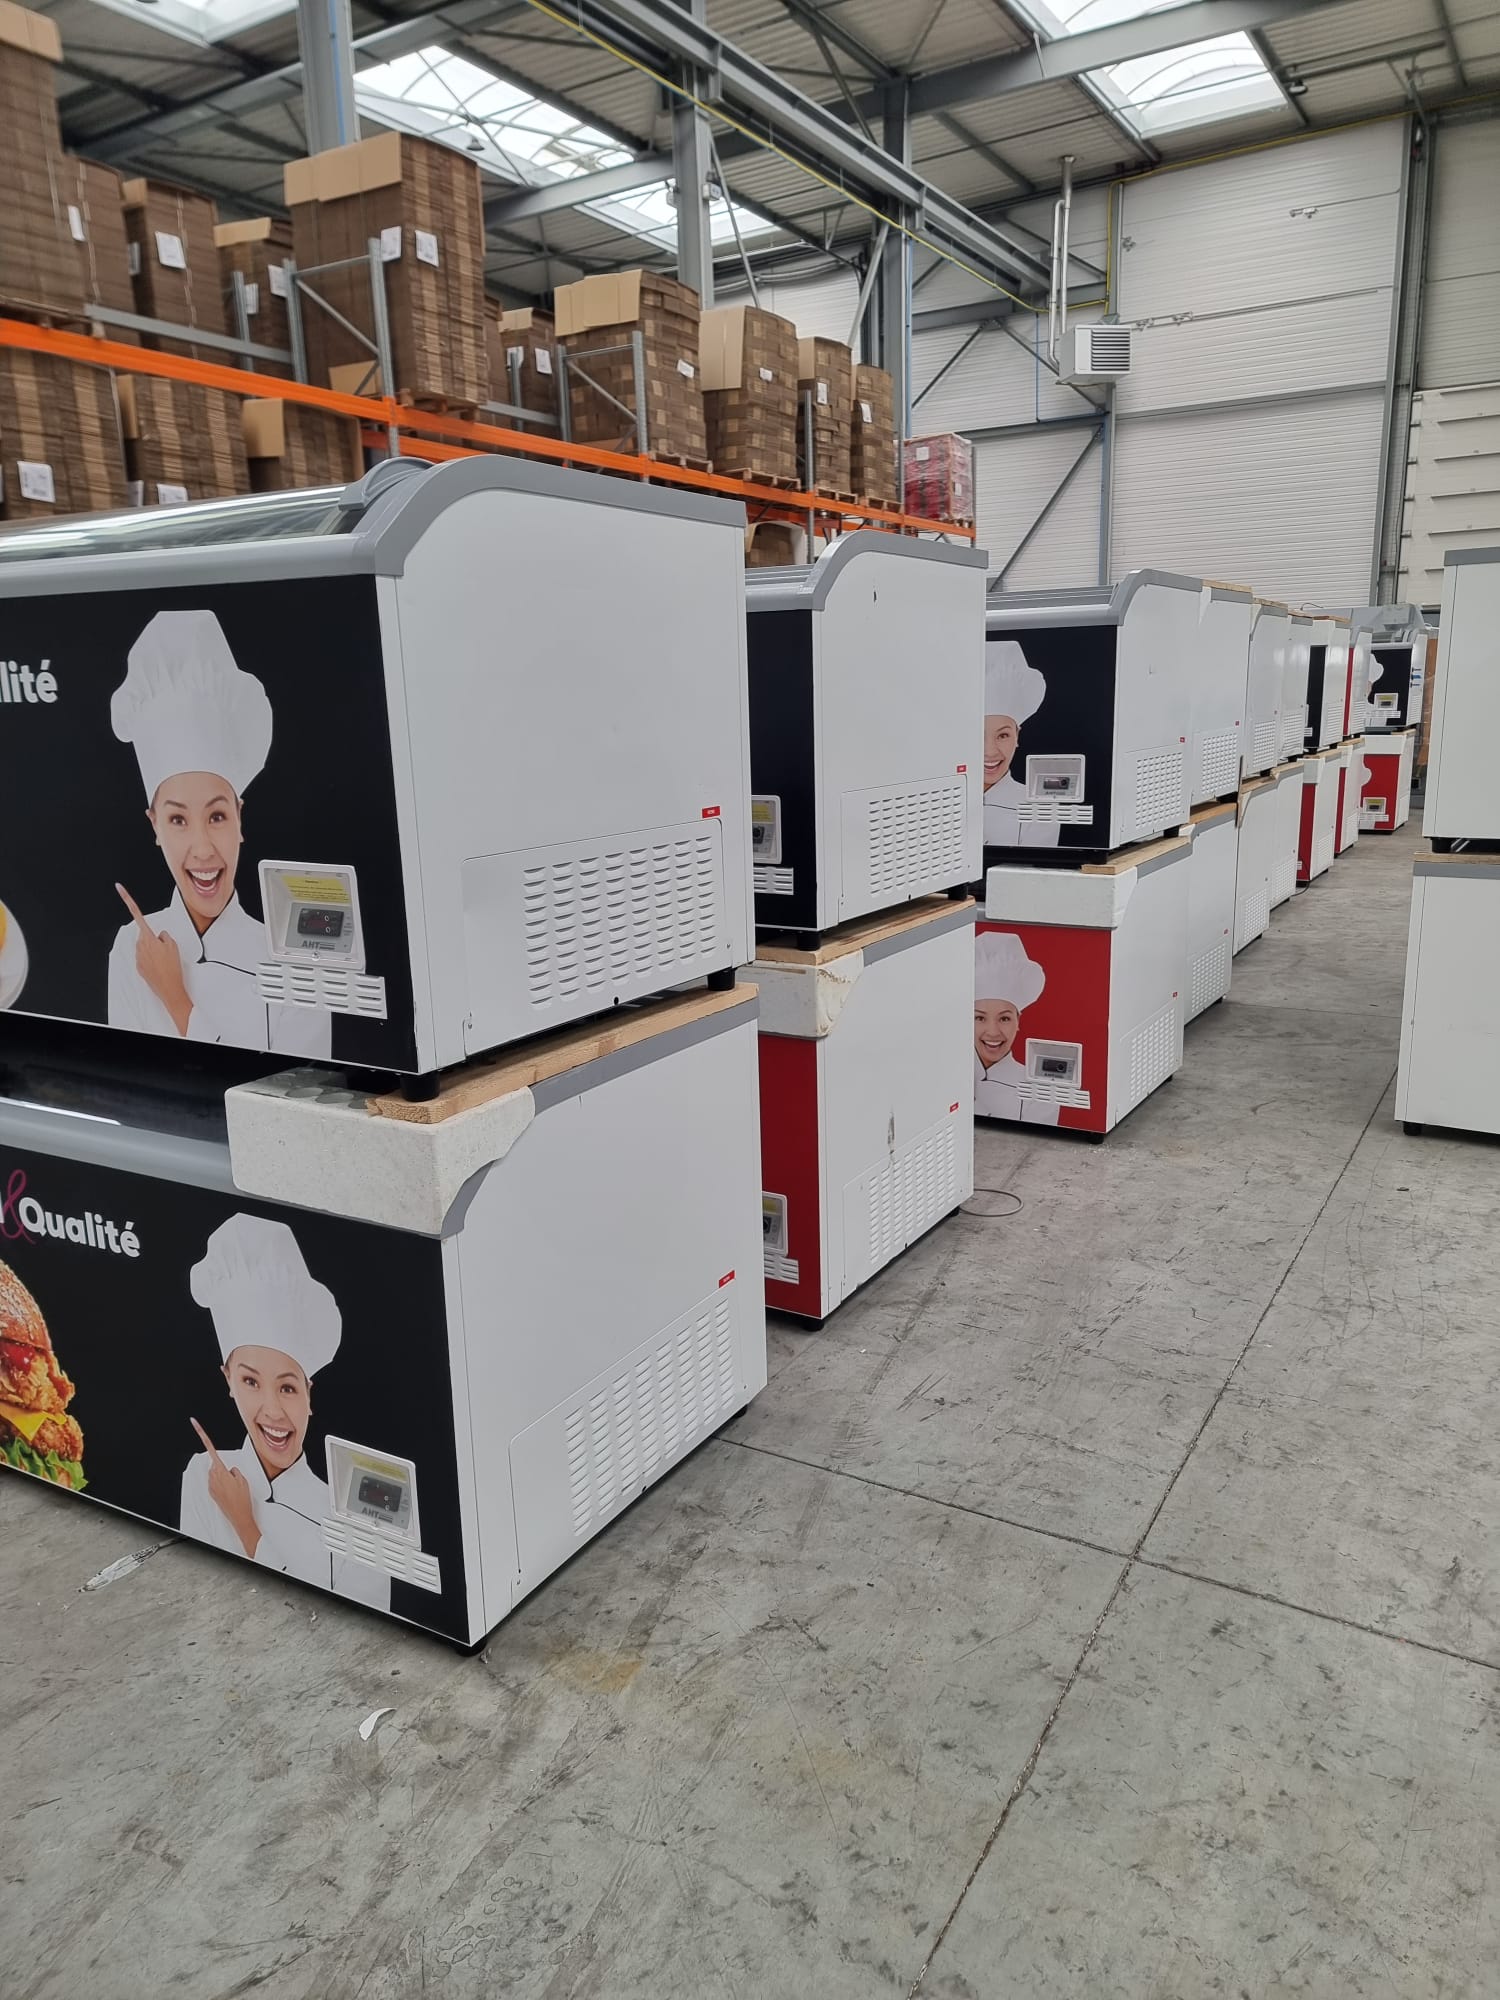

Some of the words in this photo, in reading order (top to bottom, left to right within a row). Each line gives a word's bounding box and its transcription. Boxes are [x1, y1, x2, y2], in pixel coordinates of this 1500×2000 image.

[0, 659, 58, 703] lité
[302, 940, 320, 949] AHT
[18, 1196, 141, 1258] Qualité
[361, 1506, 379, 1518] AHT
